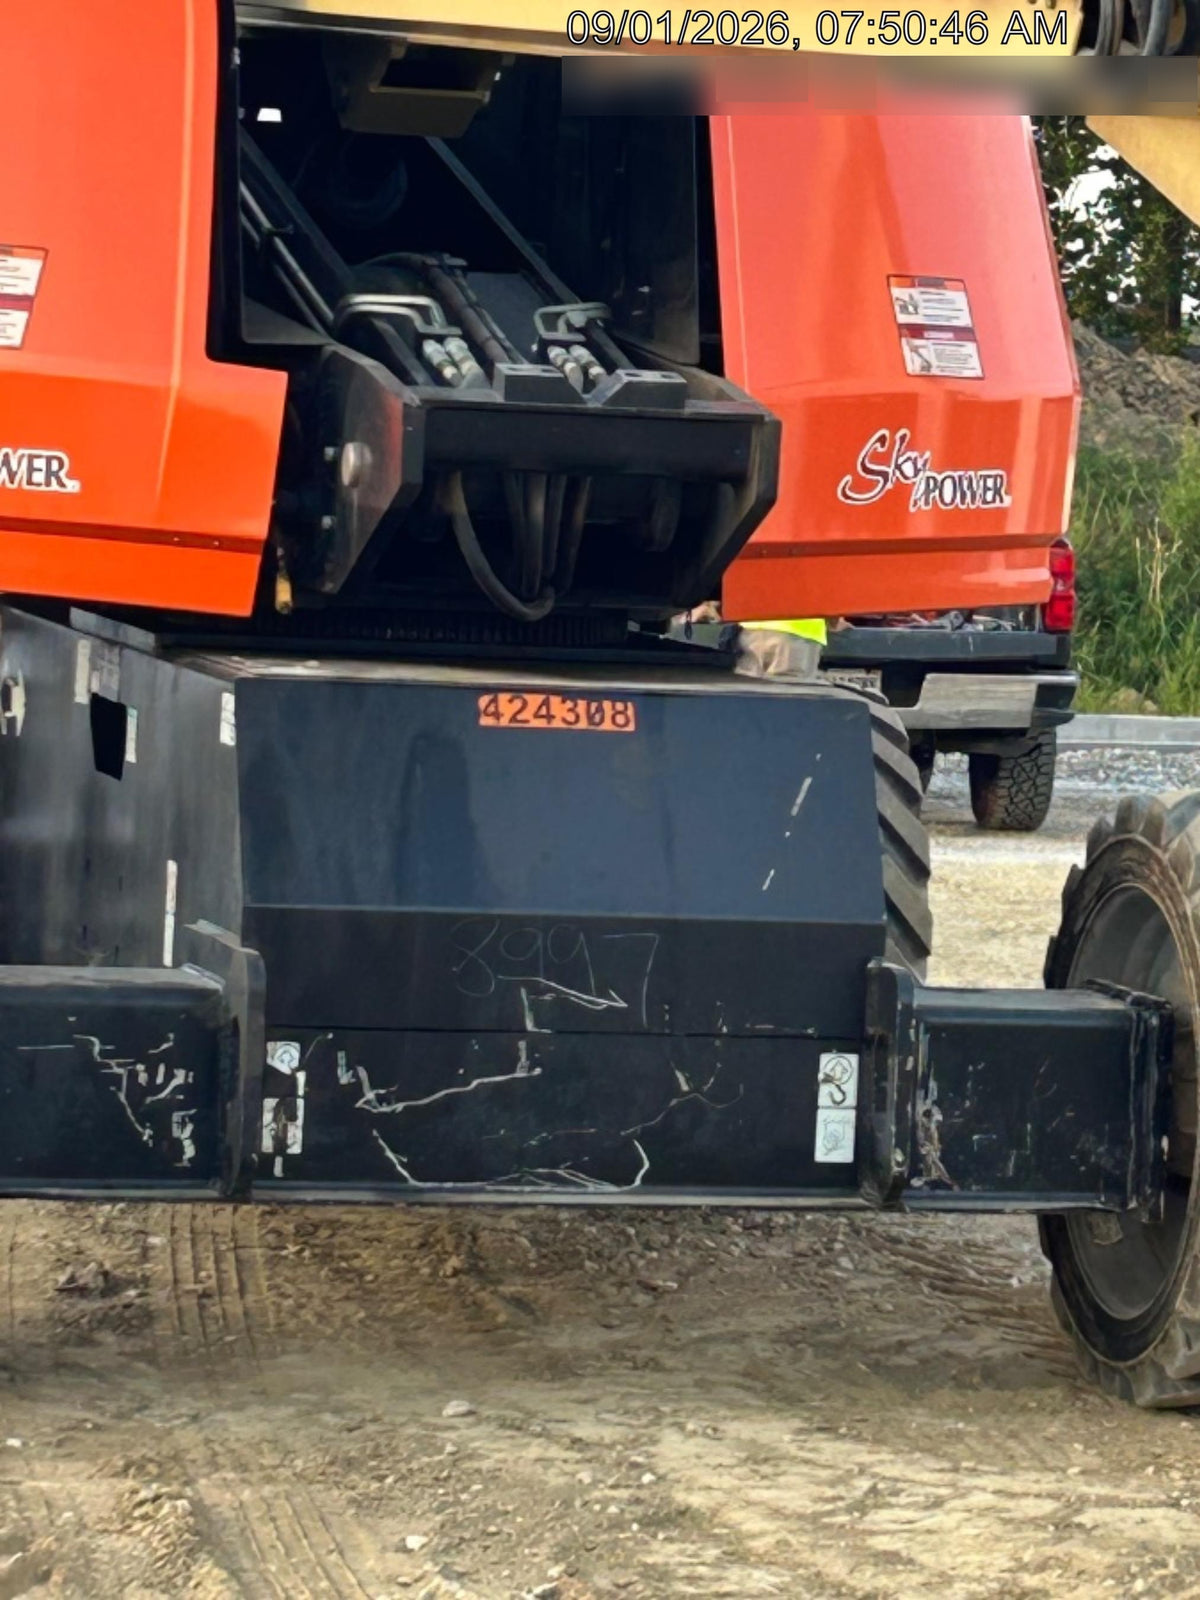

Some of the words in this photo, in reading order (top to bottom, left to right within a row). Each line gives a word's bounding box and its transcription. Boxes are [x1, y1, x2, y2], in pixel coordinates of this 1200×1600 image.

[838, 429, 930, 508] Sky
[918, 470, 1008, 510] POWER
[481, 693, 631, 729] 424308
[451, 916, 659, 1028] 8997
